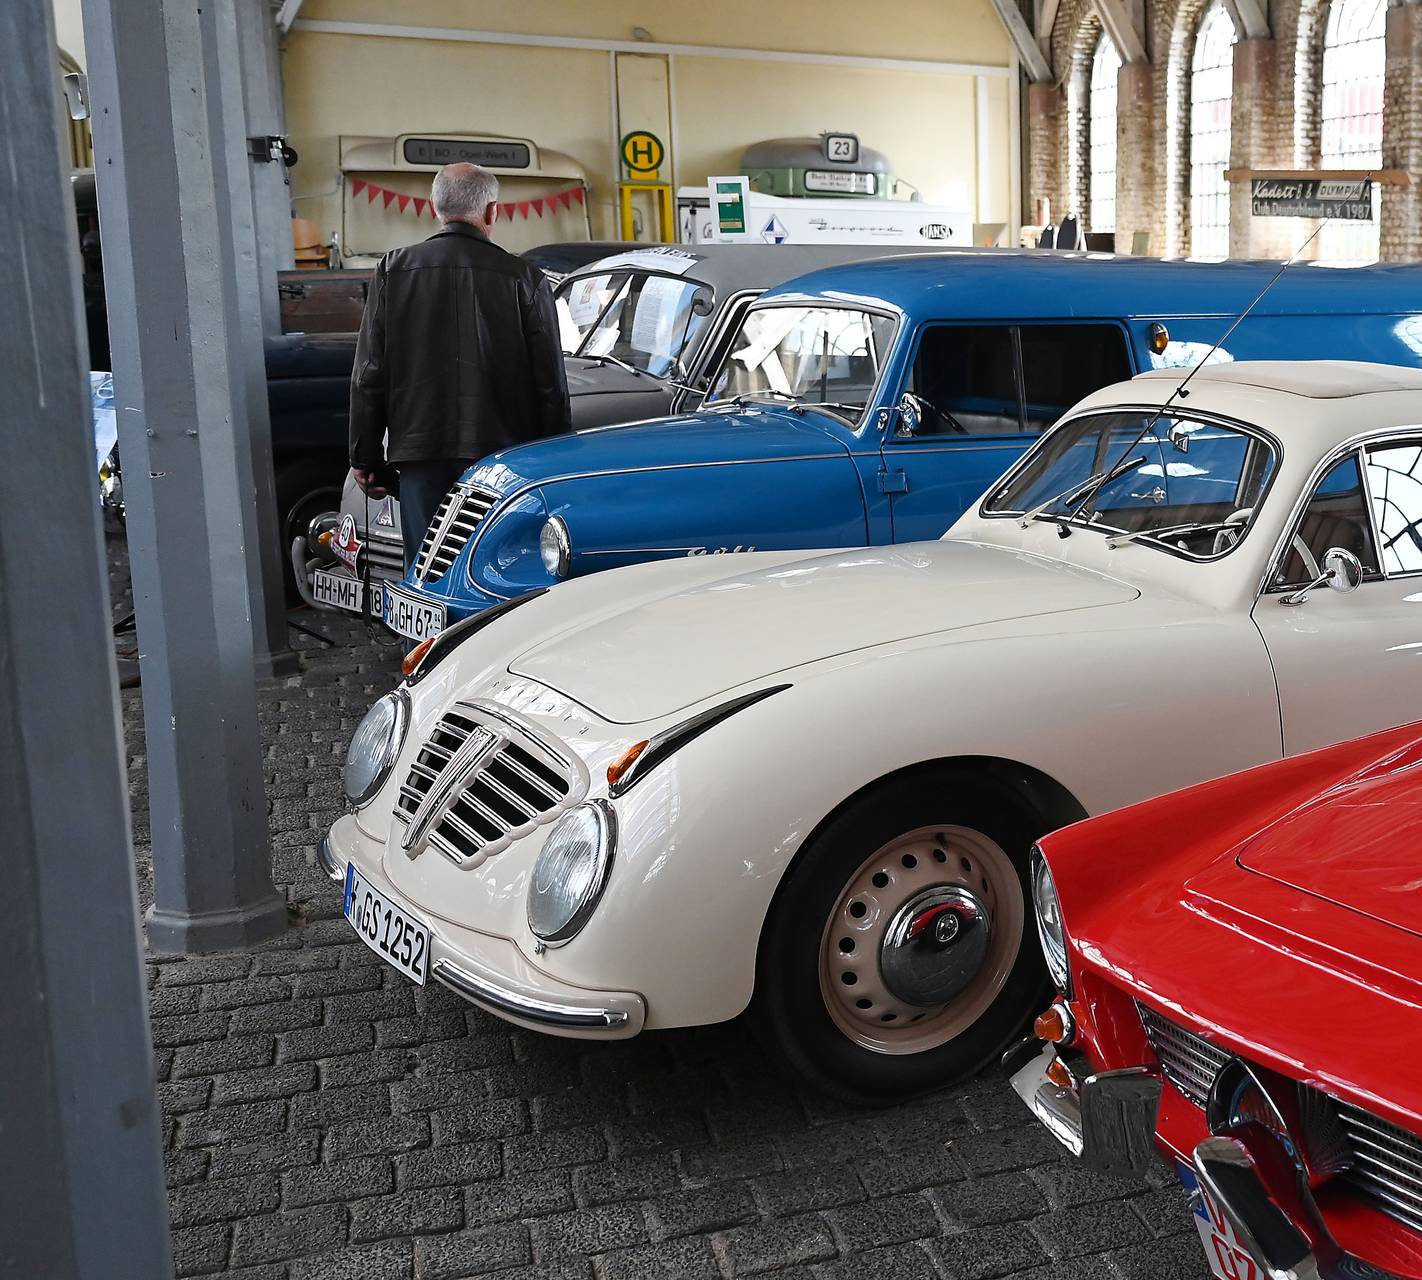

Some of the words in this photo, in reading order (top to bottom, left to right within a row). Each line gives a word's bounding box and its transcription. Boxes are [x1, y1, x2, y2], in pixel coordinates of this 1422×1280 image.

[632, 141, 653, 163] H
[834, 141, 850, 156] 23
[1252, 180, 1296, 199] Kadett
[1253, 201, 1271, 216] Club
[1271, 202, 1325, 218] Deutschland
[1346, 204, 1370, 219] 1987
[921, 223, 952, 240] HANSA
[380, 908, 425, 977] 1252
